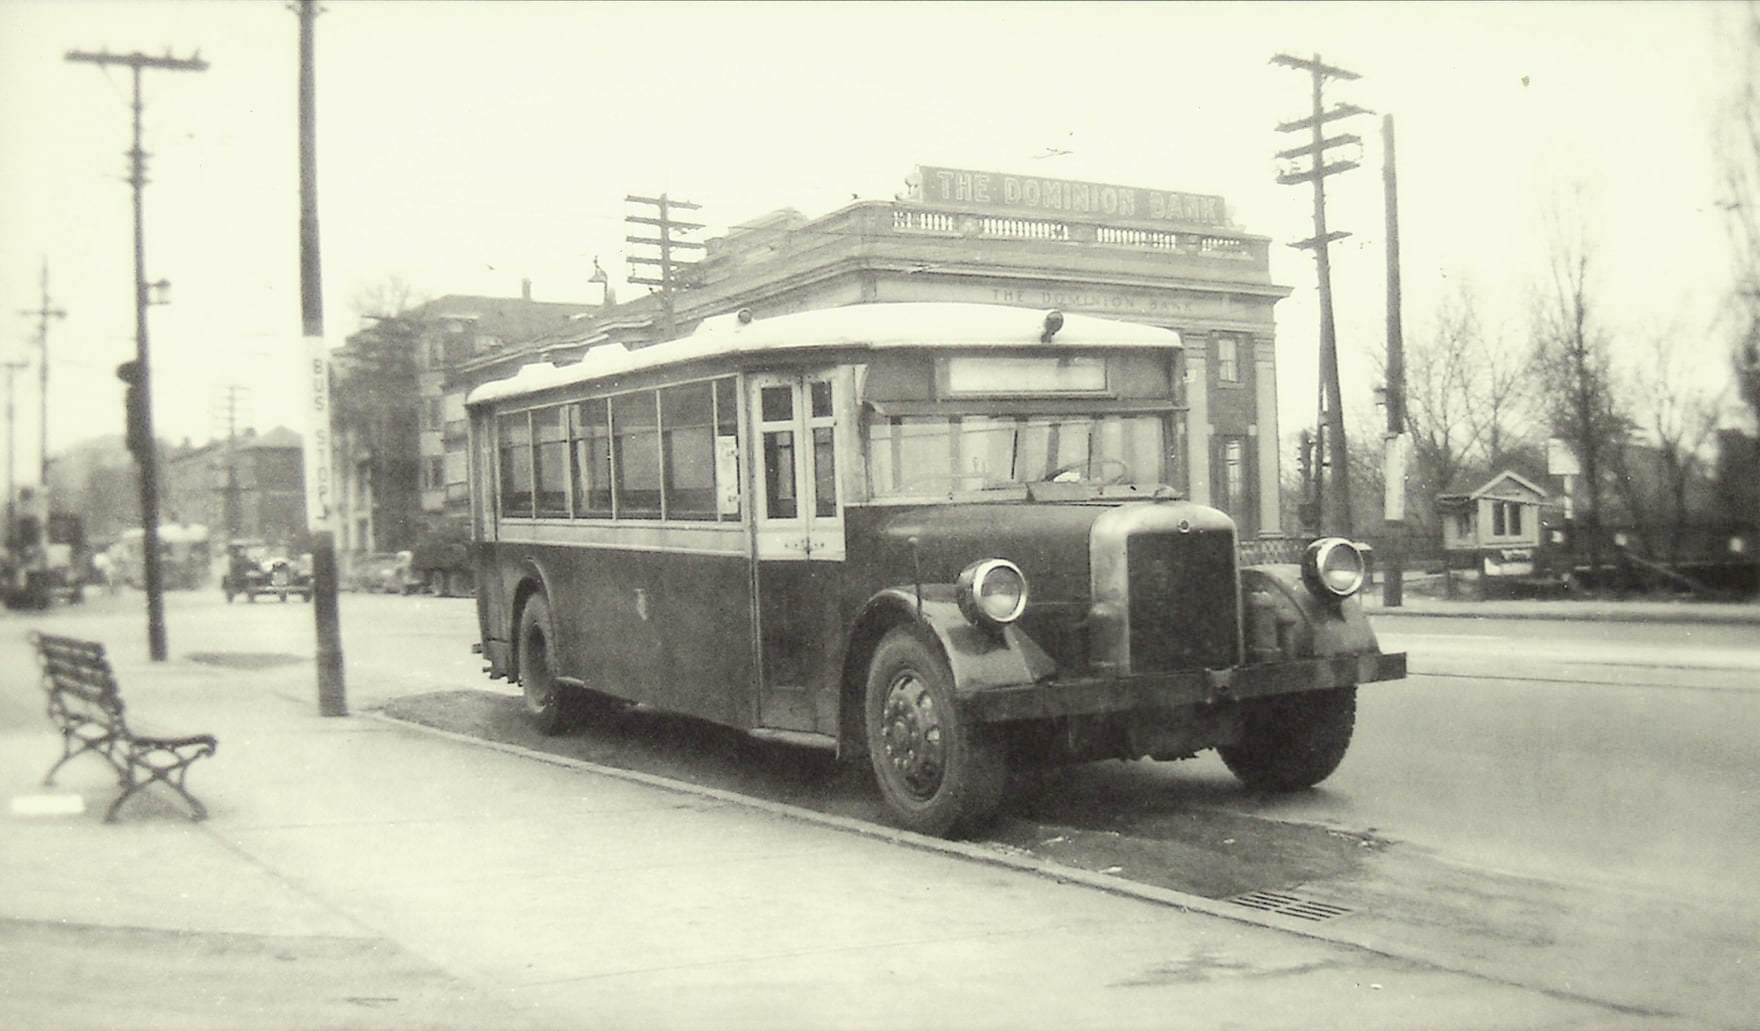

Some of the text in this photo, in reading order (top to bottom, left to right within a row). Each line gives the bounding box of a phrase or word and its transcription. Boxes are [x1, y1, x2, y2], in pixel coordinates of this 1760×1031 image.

[936, 170, 1219, 225] THE DOMINION BANK
[992, 288, 1025, 303] THE
[1041, 291, 1135, 308] DOMINION
[313, 358, 328, 502] BUS STOP
